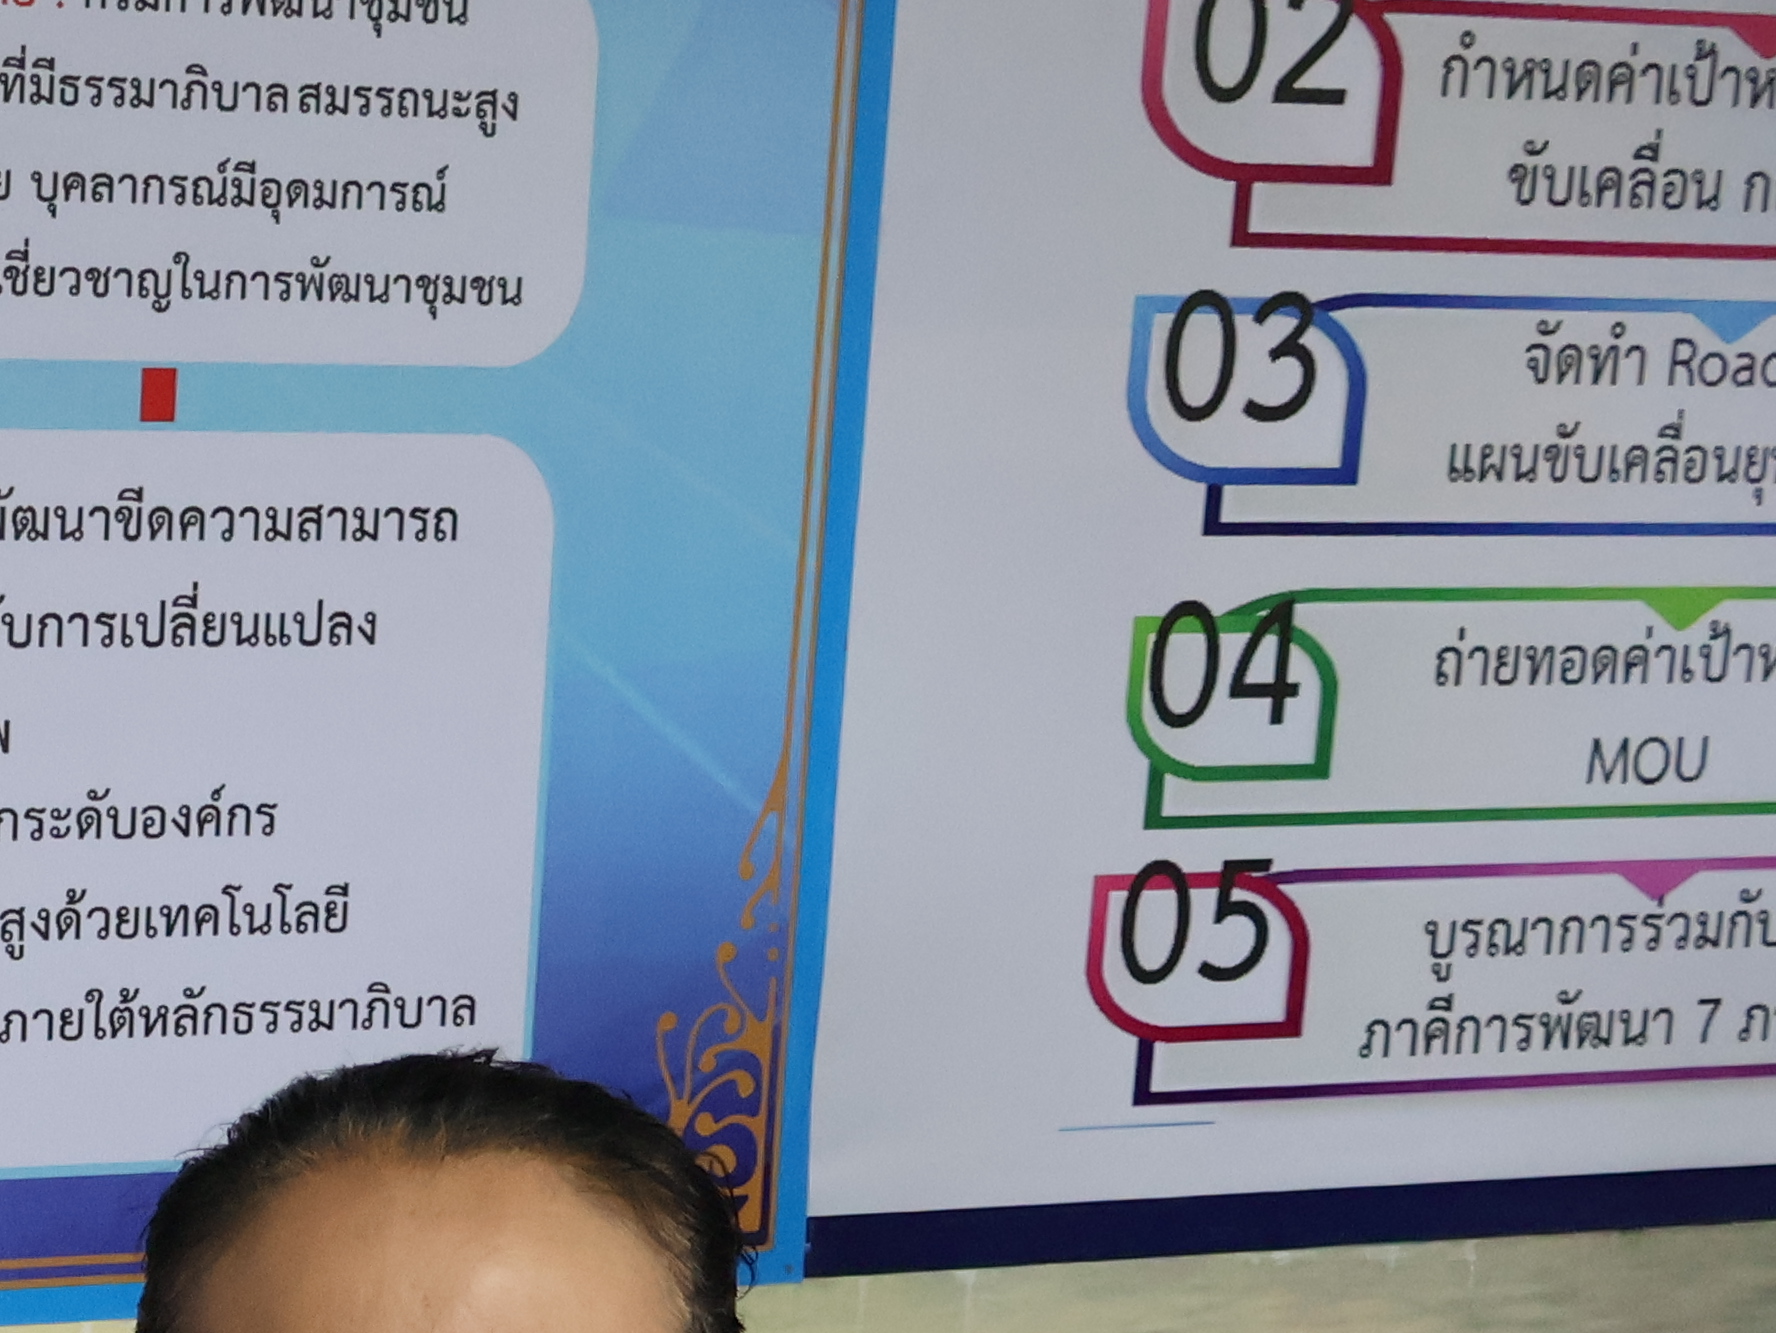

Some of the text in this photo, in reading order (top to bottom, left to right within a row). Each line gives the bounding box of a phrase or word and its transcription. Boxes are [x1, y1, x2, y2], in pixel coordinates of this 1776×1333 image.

[1194, 0, 1351, 106] 02
[1508, 129, 1723, 211] ขับเคลื่อน
[1165, 289, 1316, 422] 03
[1525, 320, 1646, 385] จัดทำ
[1149, 598, 1300, 729] 04
[1586, 736, 1709, 785] MOU
[1121, 857, 1274, 985] 05
[1359, 989, 1673, 1058] ภาคีการพัฒนา
[1697, 998, 1722, 1043] 7
